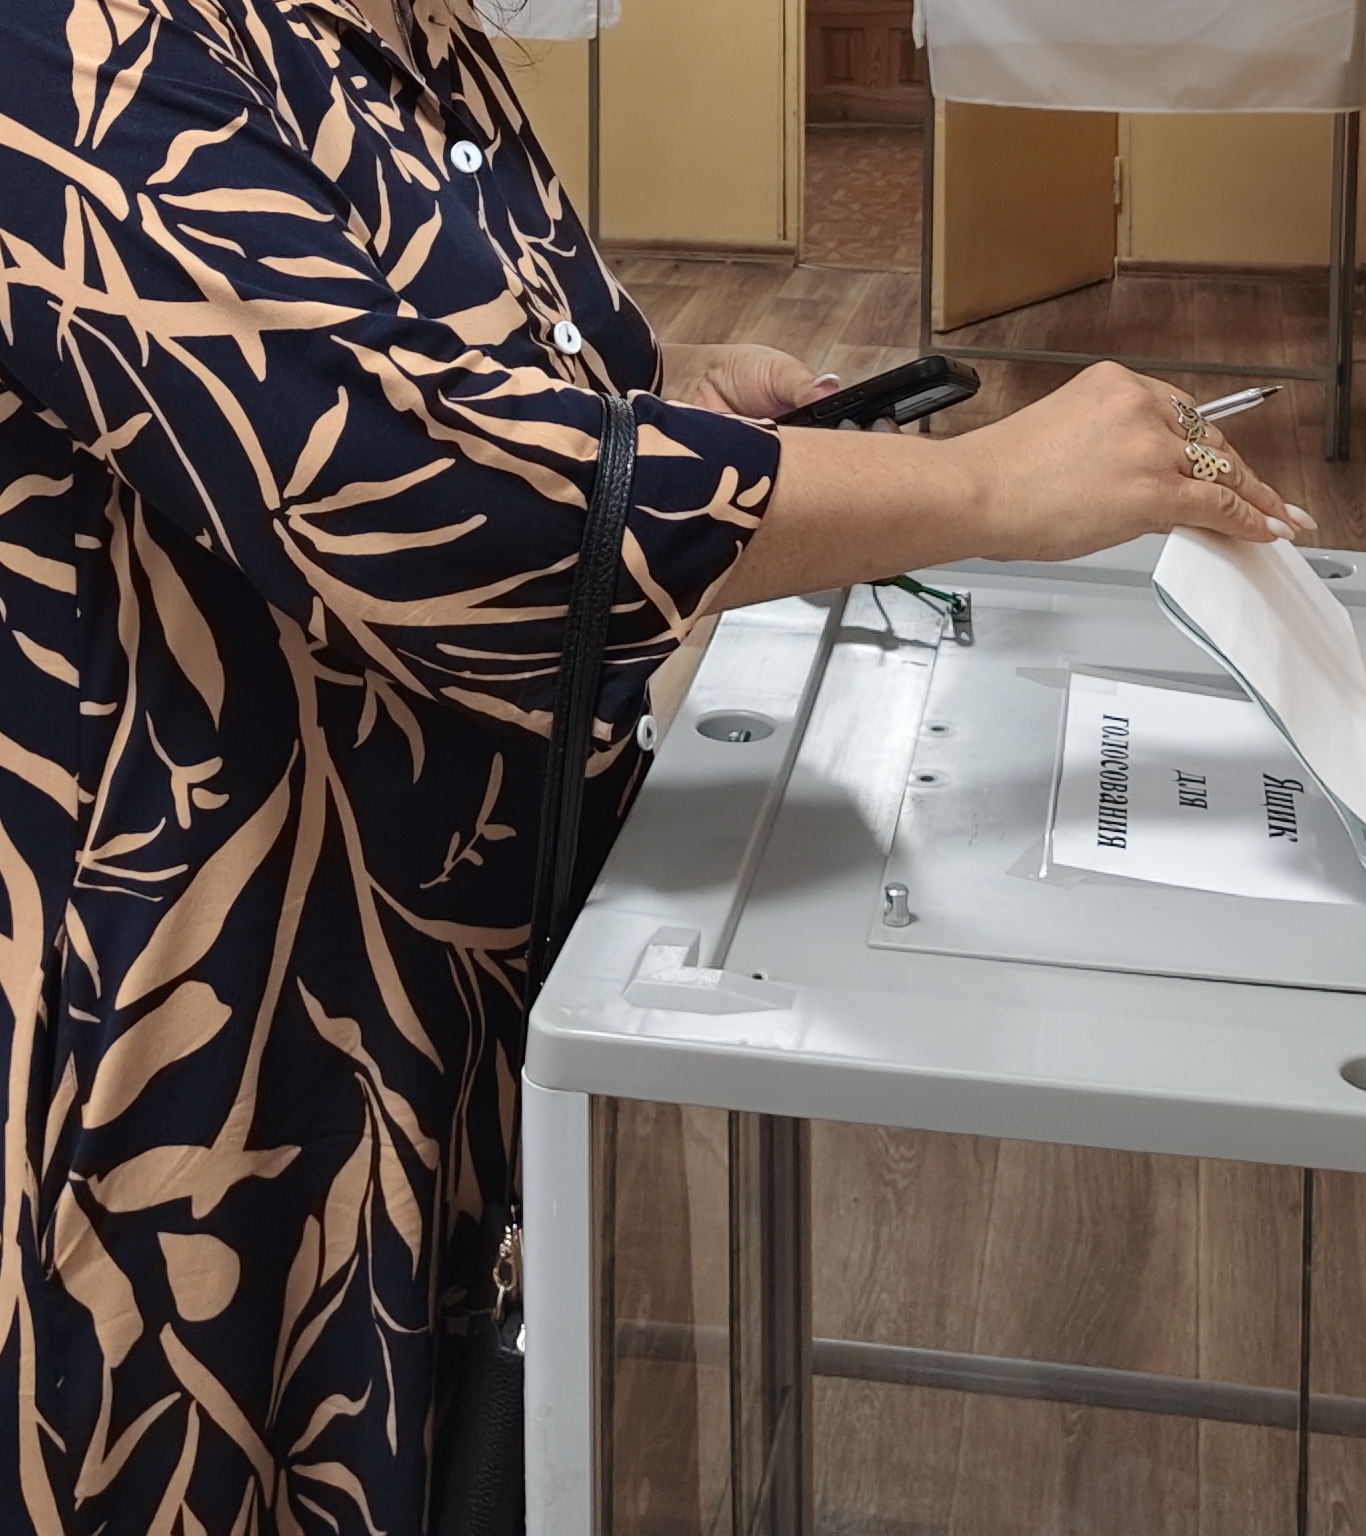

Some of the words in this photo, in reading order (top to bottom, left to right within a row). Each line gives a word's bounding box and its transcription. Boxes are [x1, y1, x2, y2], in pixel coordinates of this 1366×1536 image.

[1096, 713, 1130, 851] голосования
[1173, 768, 1209, 810] для
[1262, 772, 1305, 843] Ящик
